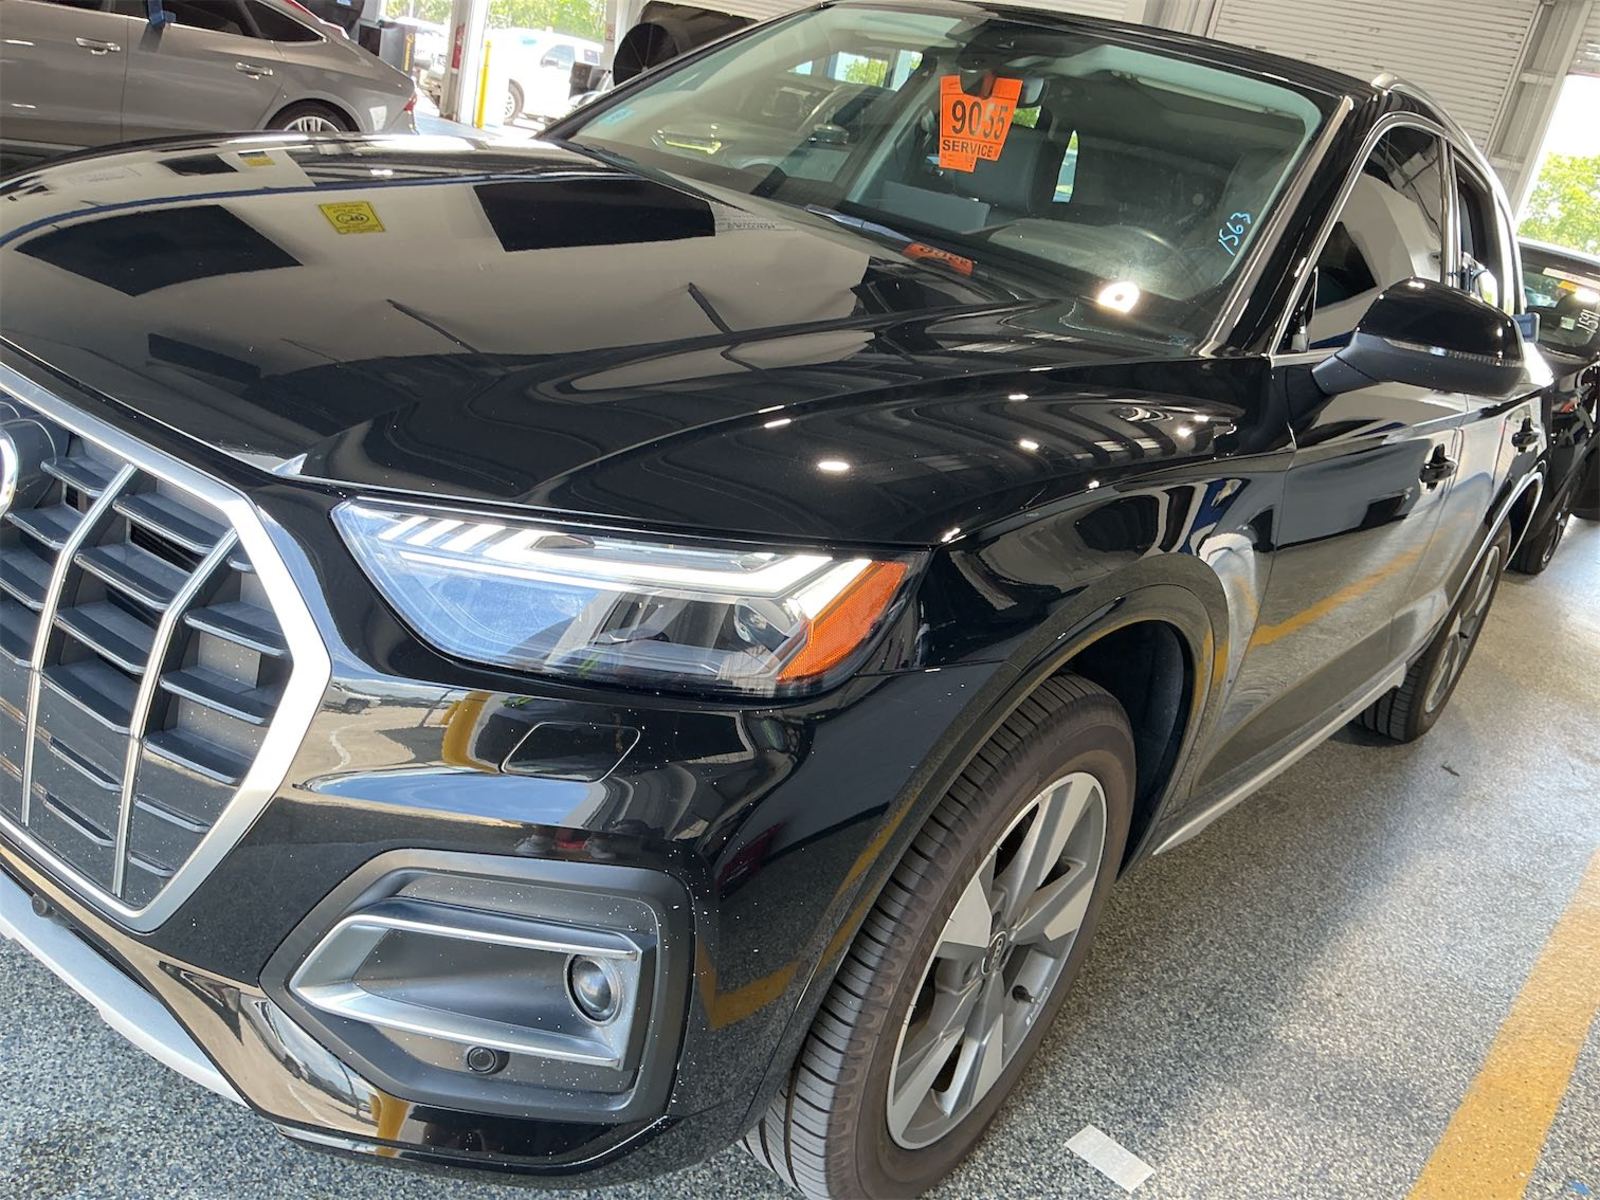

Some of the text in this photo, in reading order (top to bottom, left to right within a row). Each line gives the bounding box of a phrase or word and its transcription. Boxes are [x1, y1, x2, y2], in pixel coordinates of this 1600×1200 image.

[952, 100, 1008, 140] 9055
[942, 140, 994, 158] SERVICE
[1218, 212, 1251, 256] 1563
[1576, 308, 1600, 333] 1591
